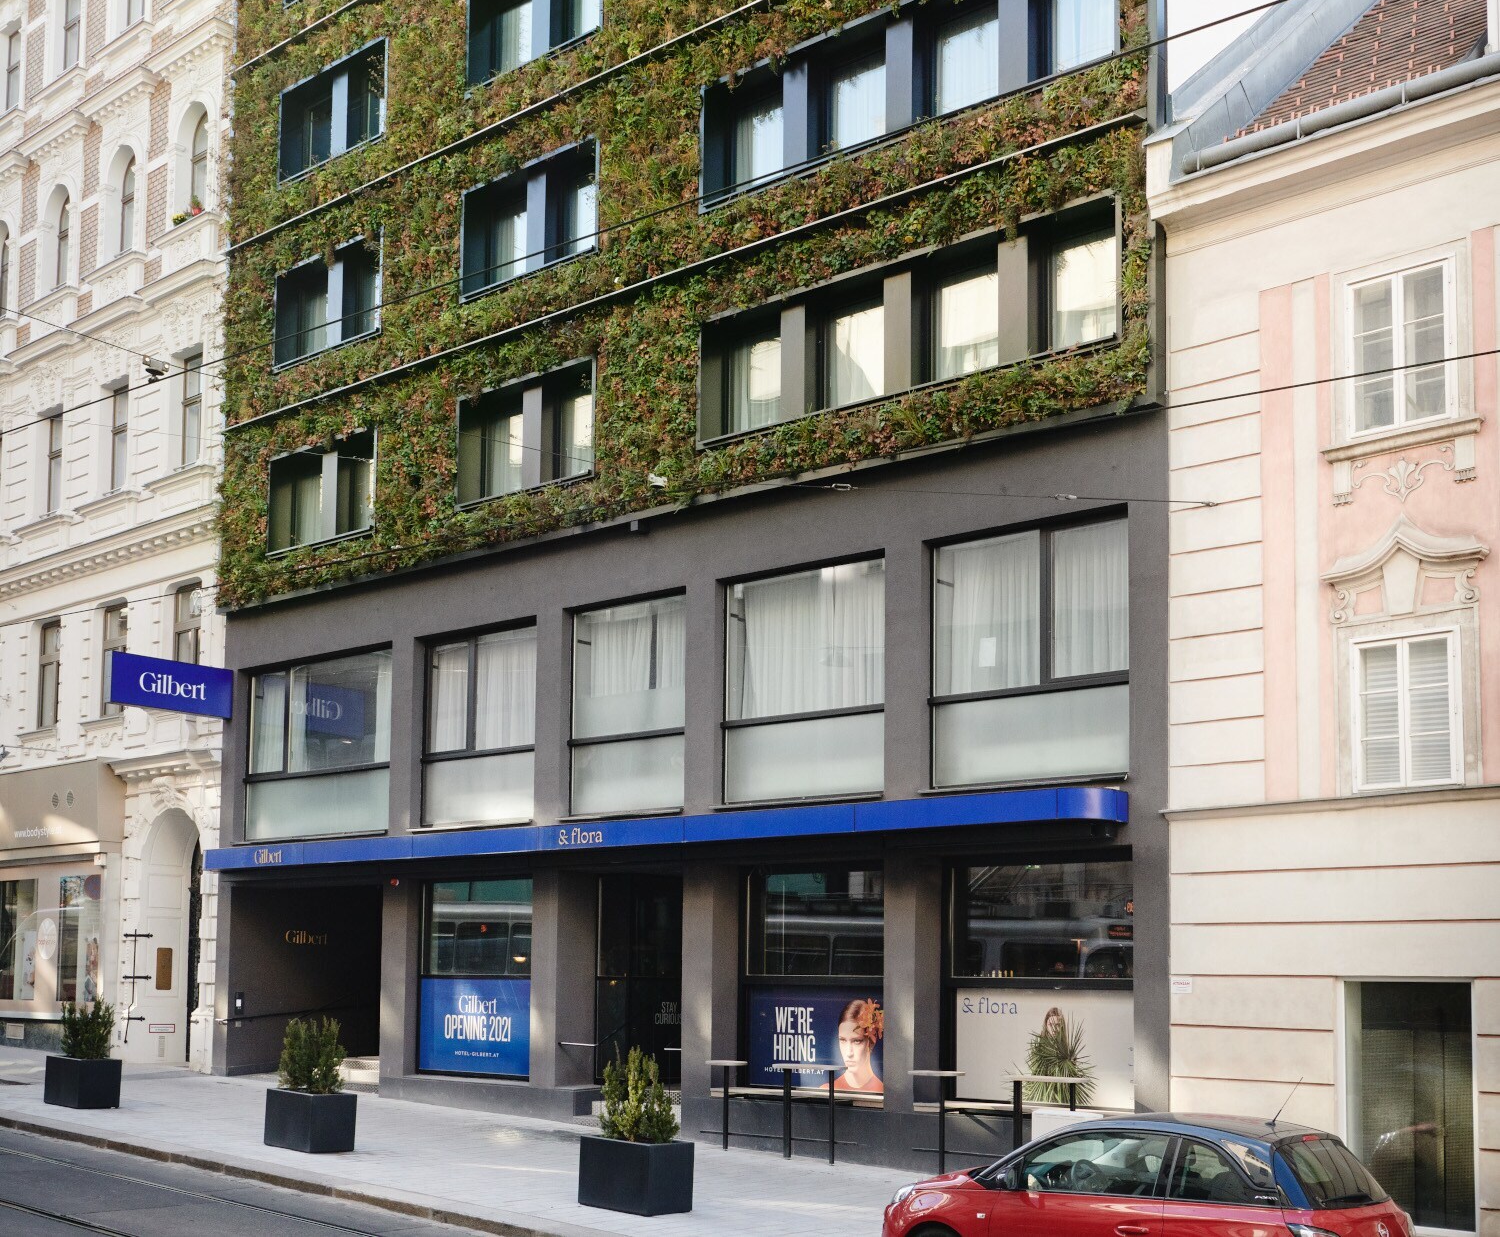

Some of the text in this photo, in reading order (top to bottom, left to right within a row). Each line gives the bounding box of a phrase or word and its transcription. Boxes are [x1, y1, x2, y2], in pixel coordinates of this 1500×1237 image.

[139, 671, 206, 700] Gilbert
[558, 827, 603, 845] & flora
[254, 848, 282, 864] Gilbert
[285, 929, 328, 945] Gilbert
[458, 994, 497, 1014] Gilbert
[661, 1001, 678, 1013] STAY
[962, 996, 1018, 1014] & flora
[444, 1013, 511, 1042] OPENING 2021
[454, 1050, 499, 1058] HOTEL-GILBERT.AT
[773, 1033, 816, 1062] HIRING
[764, 1066, 825, 1075] HOTELILBERT.AT
